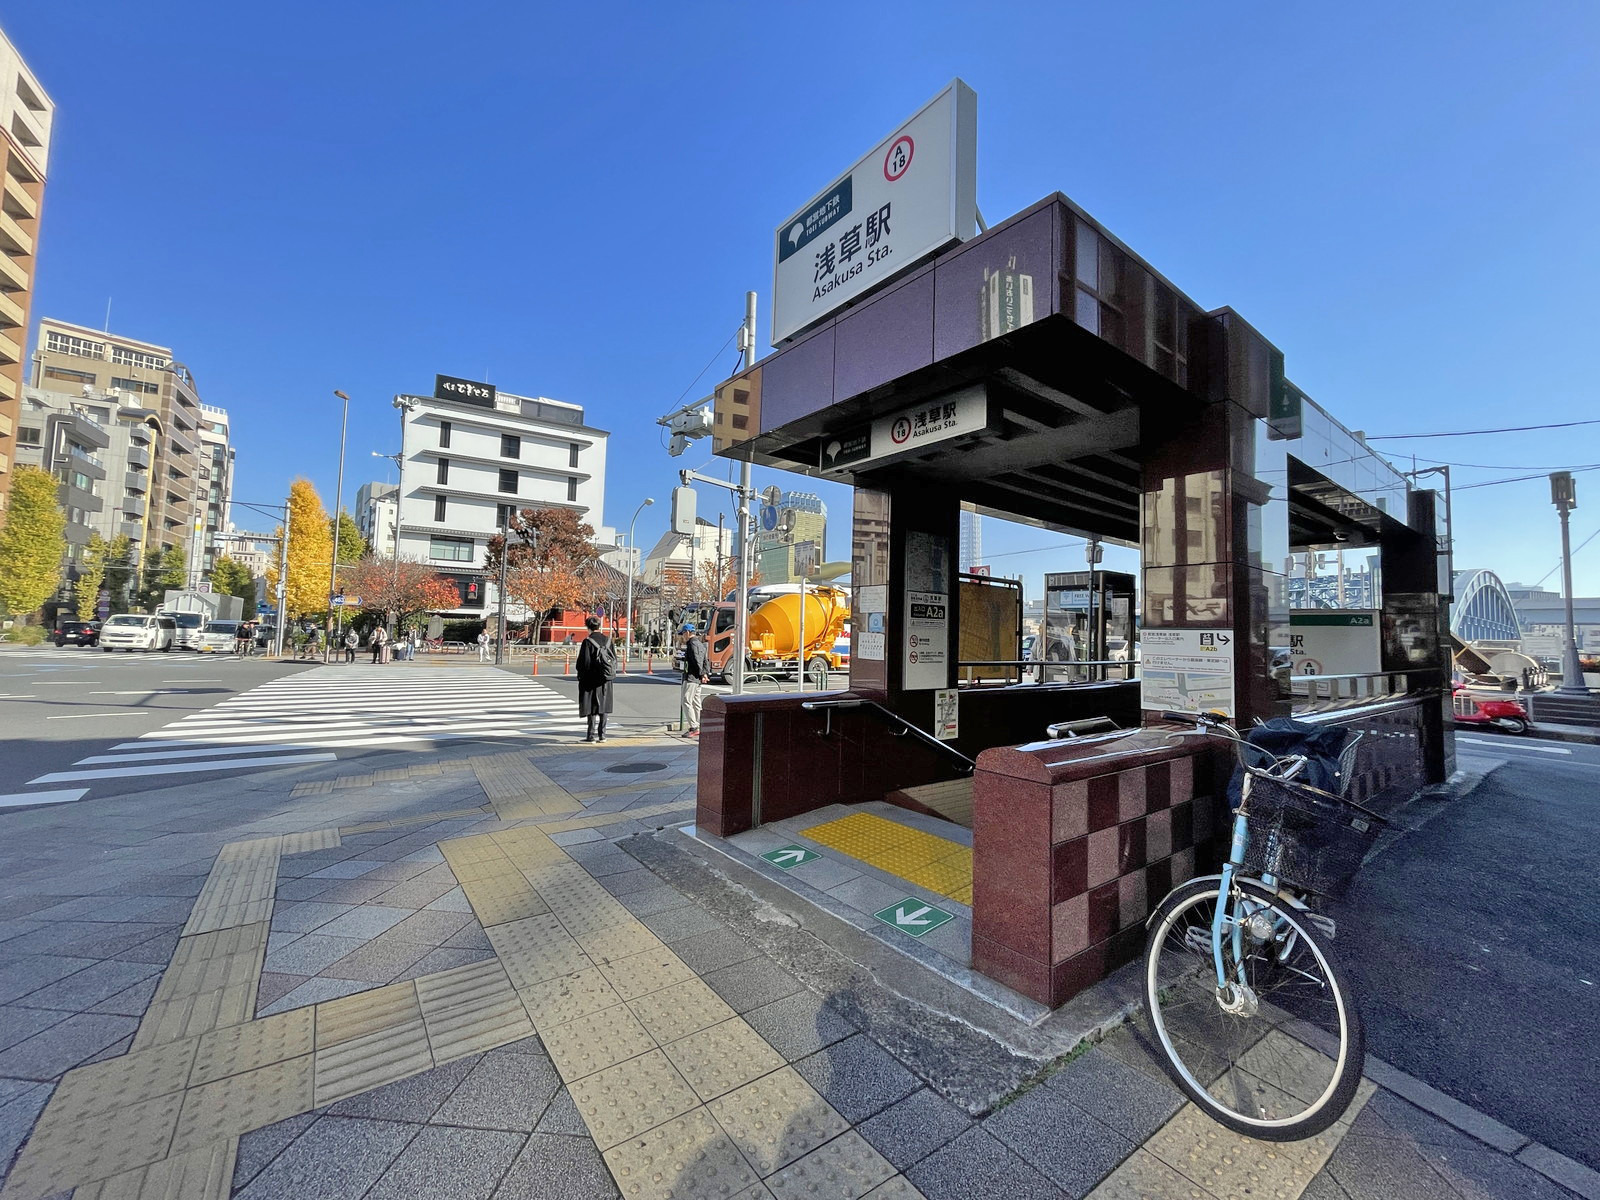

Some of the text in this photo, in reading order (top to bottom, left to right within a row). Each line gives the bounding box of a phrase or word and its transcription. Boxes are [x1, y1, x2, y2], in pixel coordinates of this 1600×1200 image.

[894, 144, 903, 159] A
[892, 155, 906, 173] 18
[806, 194, 840, 227] 都営地下鉄
[818, 206, 840, 228] SUBWAY
[814, 202, 891, 283] 浅草駅
[812, 245, 893, 302] Asakusa Sta.
[914, 402, 956, 428] 浅草駅
[896, 429, 906, 438] 18
[912, 419, 958, 438] Asakusa Sta.
[926, 606, 944, 618] A2a
[1290, 634, 1303, 647] 駅
